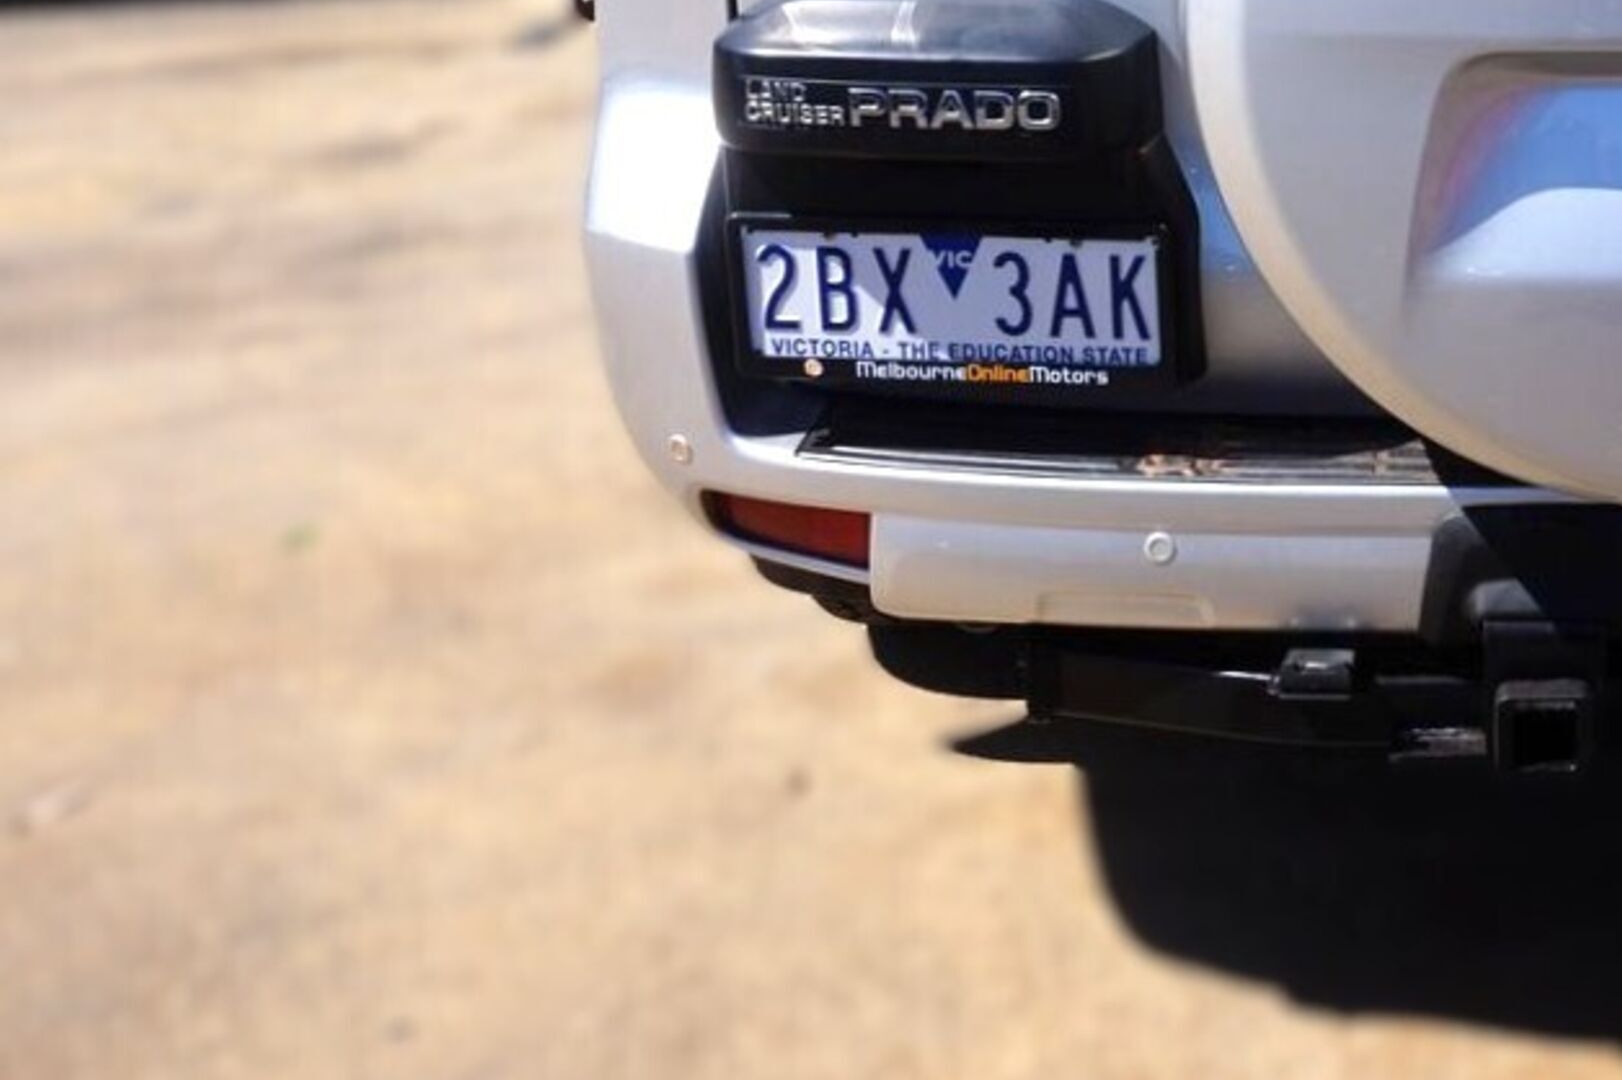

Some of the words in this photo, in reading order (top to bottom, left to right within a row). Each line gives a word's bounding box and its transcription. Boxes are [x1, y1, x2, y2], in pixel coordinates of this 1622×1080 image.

[746, 79, 806, 102] LAND
[746, 100, 845, 126] CRUISER
[848, 87, 1062, 131] PRADO
[927, 249, 974, 269] VIC
[757, 244, 917, 335] 2BX
[994, 252, 1151, 341] 3AK
[771, 338, 875, 359] VICTORIA
[897, 341, 940, 360] THE
[948, 343, 1075, 364] EDUCATION
[1083, 347, 1148, 366] STATE
